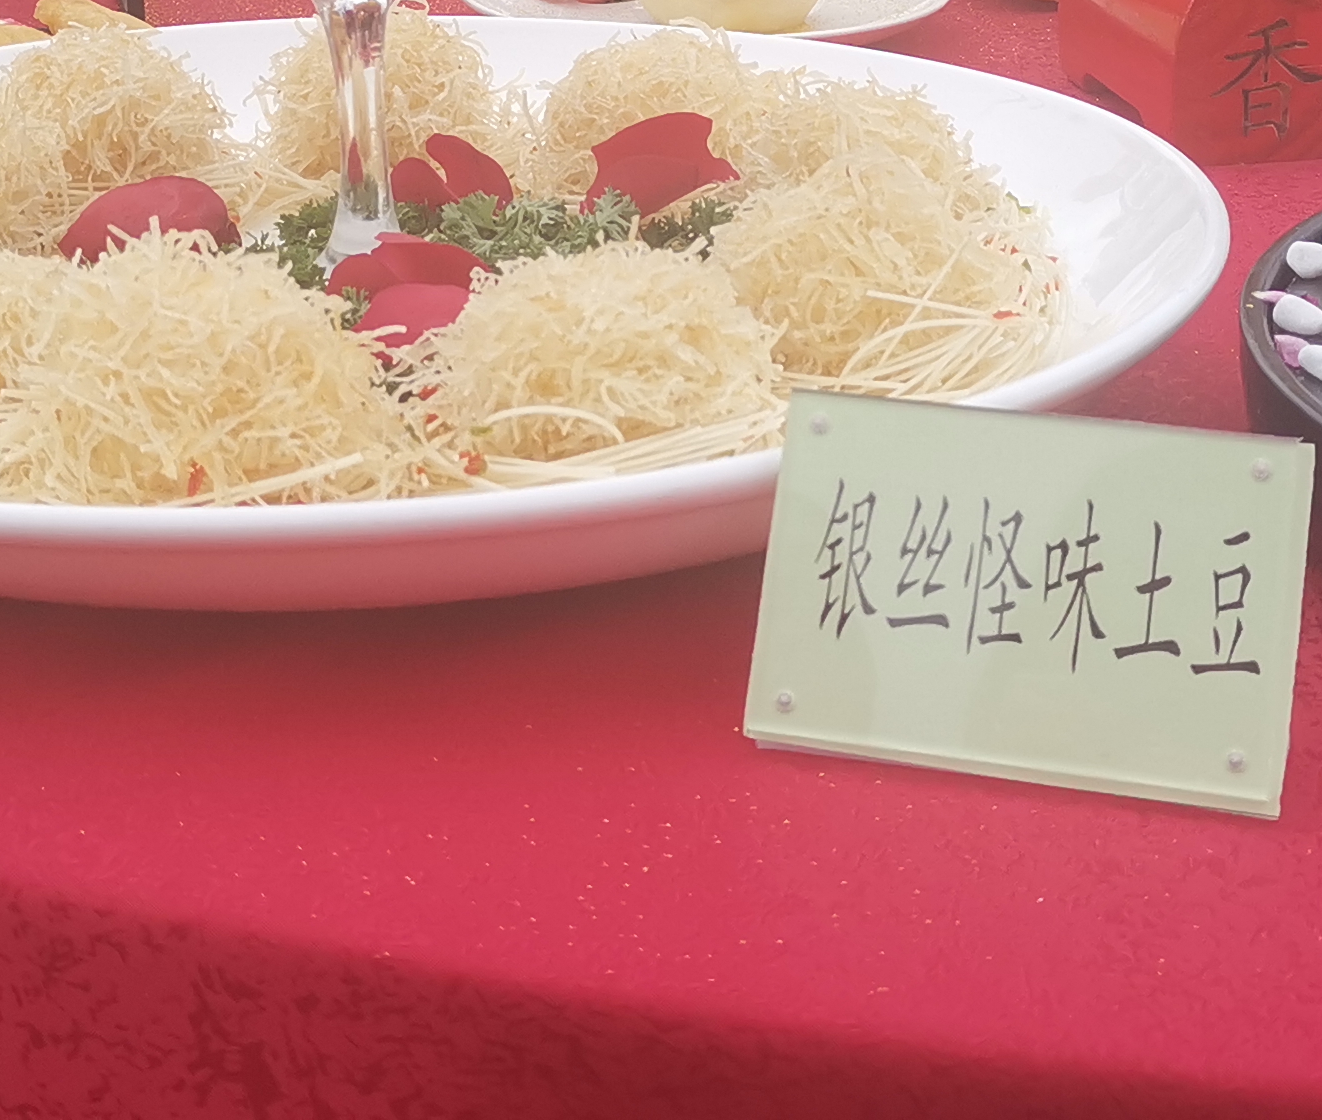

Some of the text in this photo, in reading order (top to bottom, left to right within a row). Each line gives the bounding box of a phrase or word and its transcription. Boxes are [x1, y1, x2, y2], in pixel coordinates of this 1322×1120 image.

[812, 476, 1262, 676] 银丝怪味土豆
